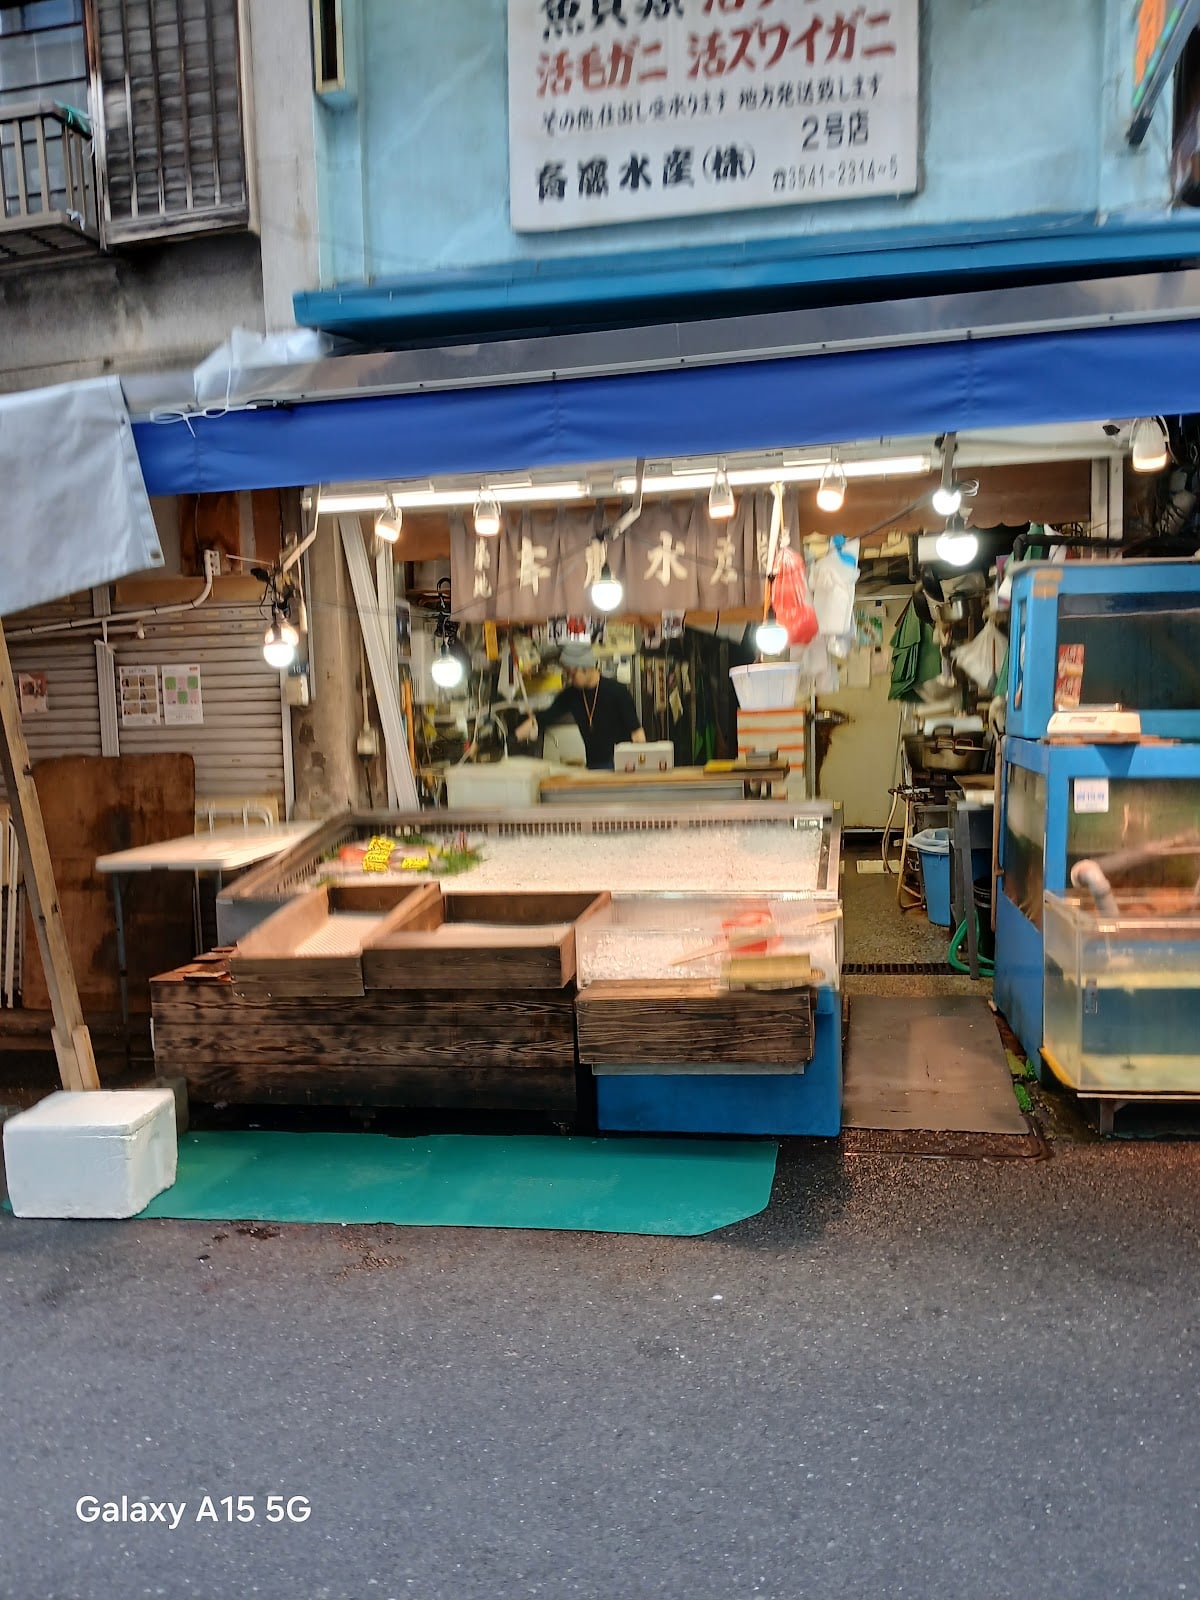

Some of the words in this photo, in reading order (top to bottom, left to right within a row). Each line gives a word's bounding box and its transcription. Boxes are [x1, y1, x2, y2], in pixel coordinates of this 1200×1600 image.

[536, 34, 669, 98] 活毛ガニ
[686, 5, 897, 79] 活ズワイガニ
[739, 74, 882, 110] 地方発送致します
[802, 107, 870, 152] 2号店
